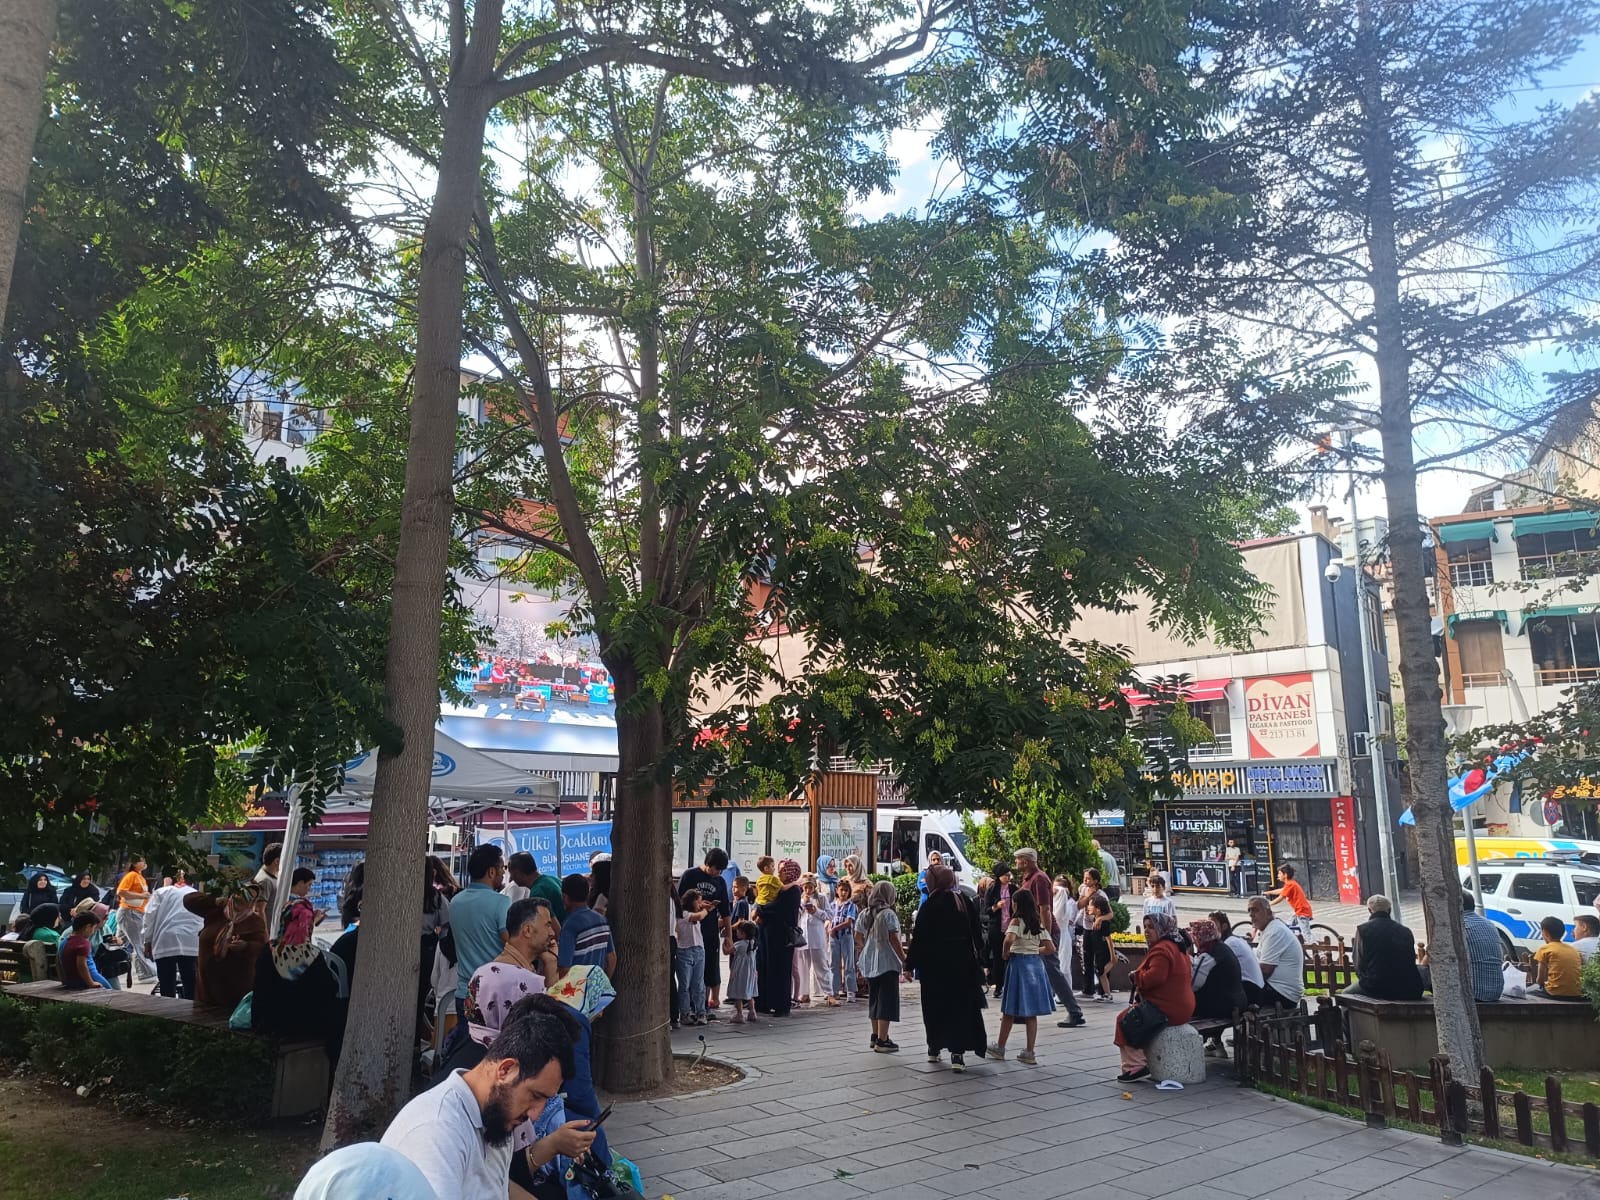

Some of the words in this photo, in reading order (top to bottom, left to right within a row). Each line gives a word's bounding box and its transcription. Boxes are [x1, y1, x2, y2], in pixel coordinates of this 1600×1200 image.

[1248, 692, 1311, 713] DİVAN
[1249, 708, 1312, 722] PASTANESİ
[1270, 730, 1283, 739] 213
[1336, 802, 1346, 828] PALA
[521, 833, 550, 851] Ülkü
[822, 832, 841, 847] SENİN
